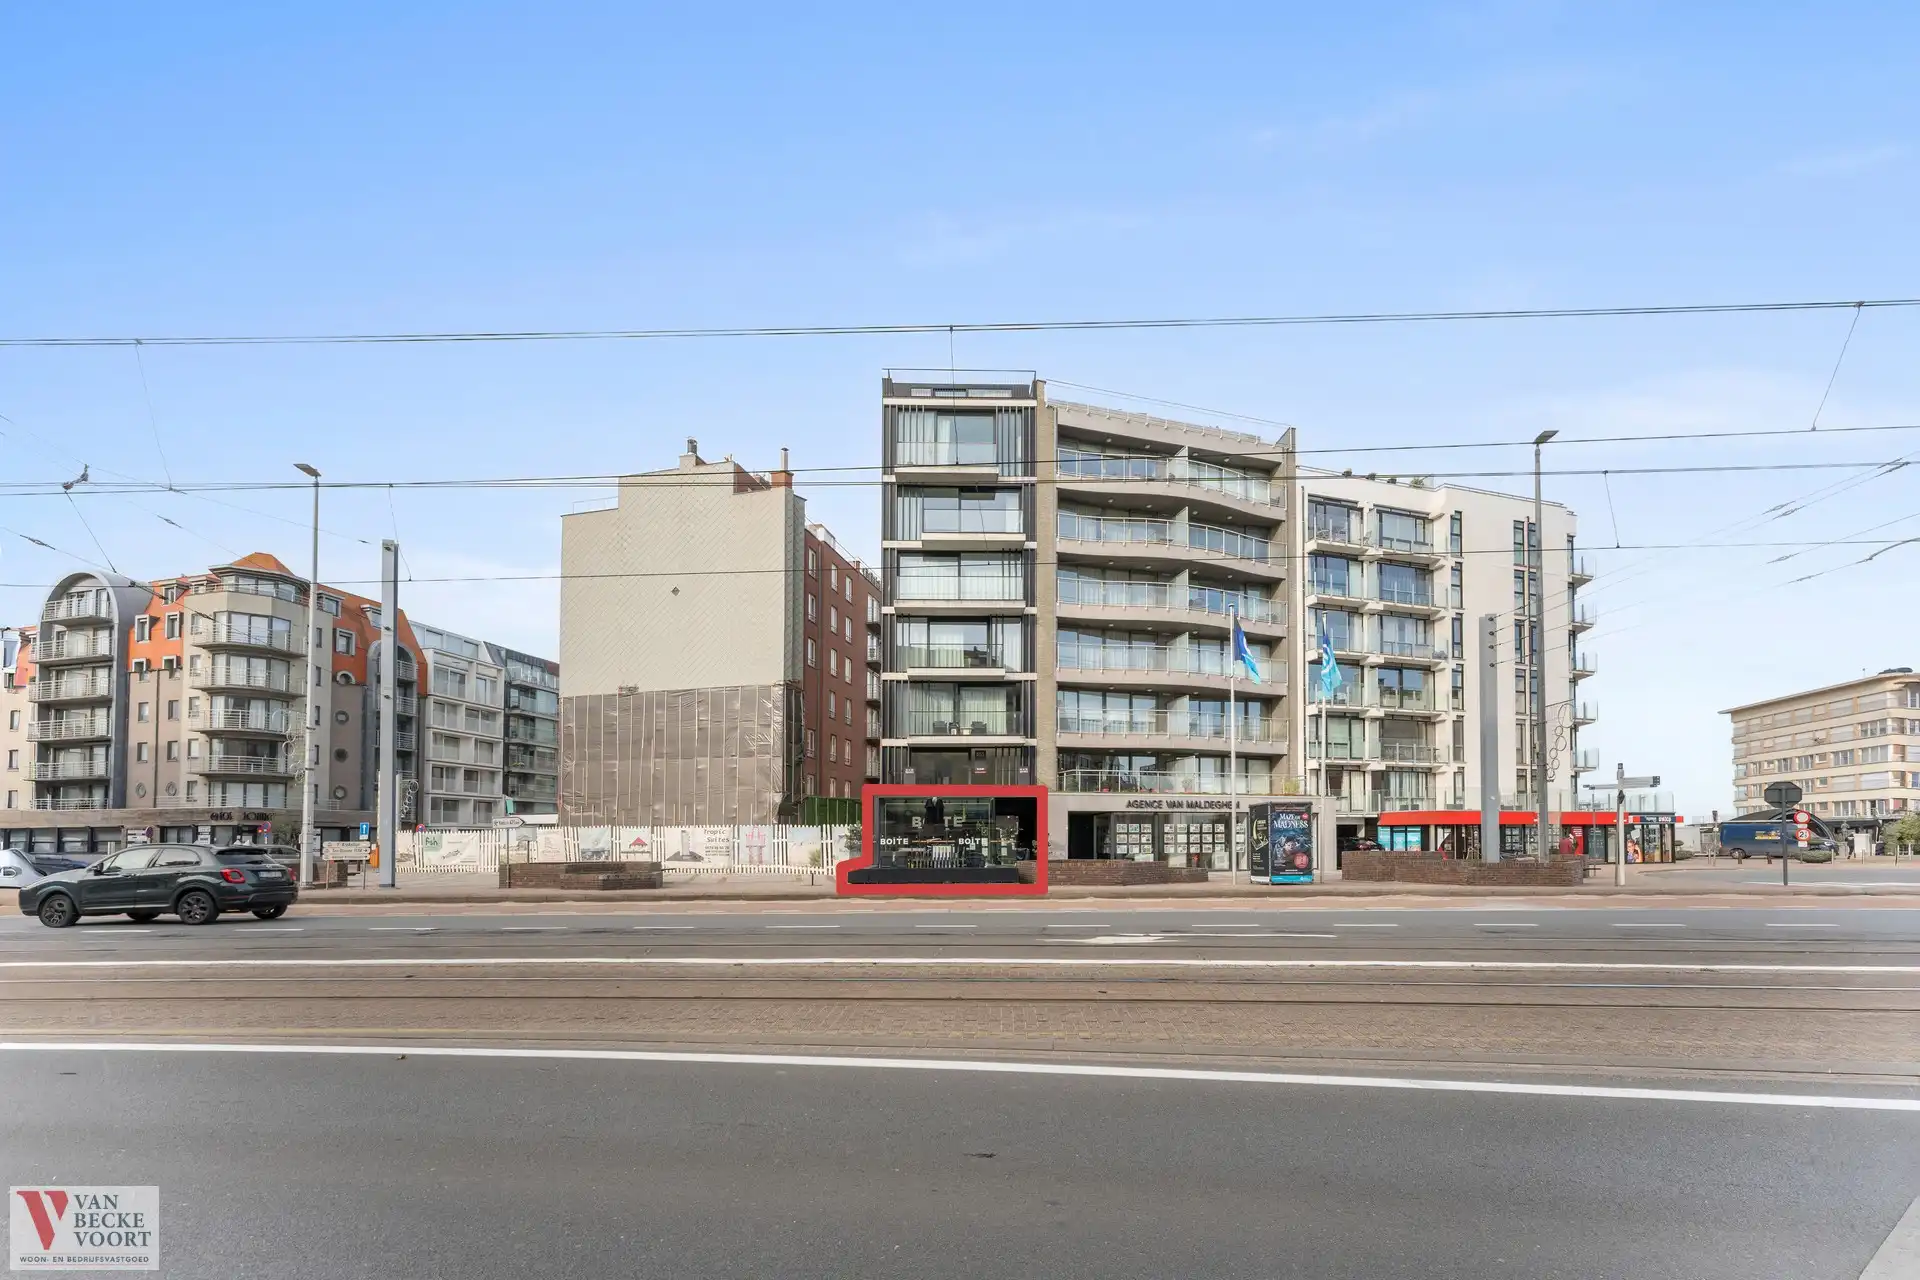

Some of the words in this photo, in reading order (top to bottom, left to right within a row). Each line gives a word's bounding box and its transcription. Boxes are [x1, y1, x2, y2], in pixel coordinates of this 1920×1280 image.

[1126, 800, 1163, 809] AGENCE
[1165, 800, 1184, 809] VAN
[912, 816, 963, 828] BTE
[1273, 819, 1309, 829] MADNESS
[704, 828, 726, 836] Tropic
